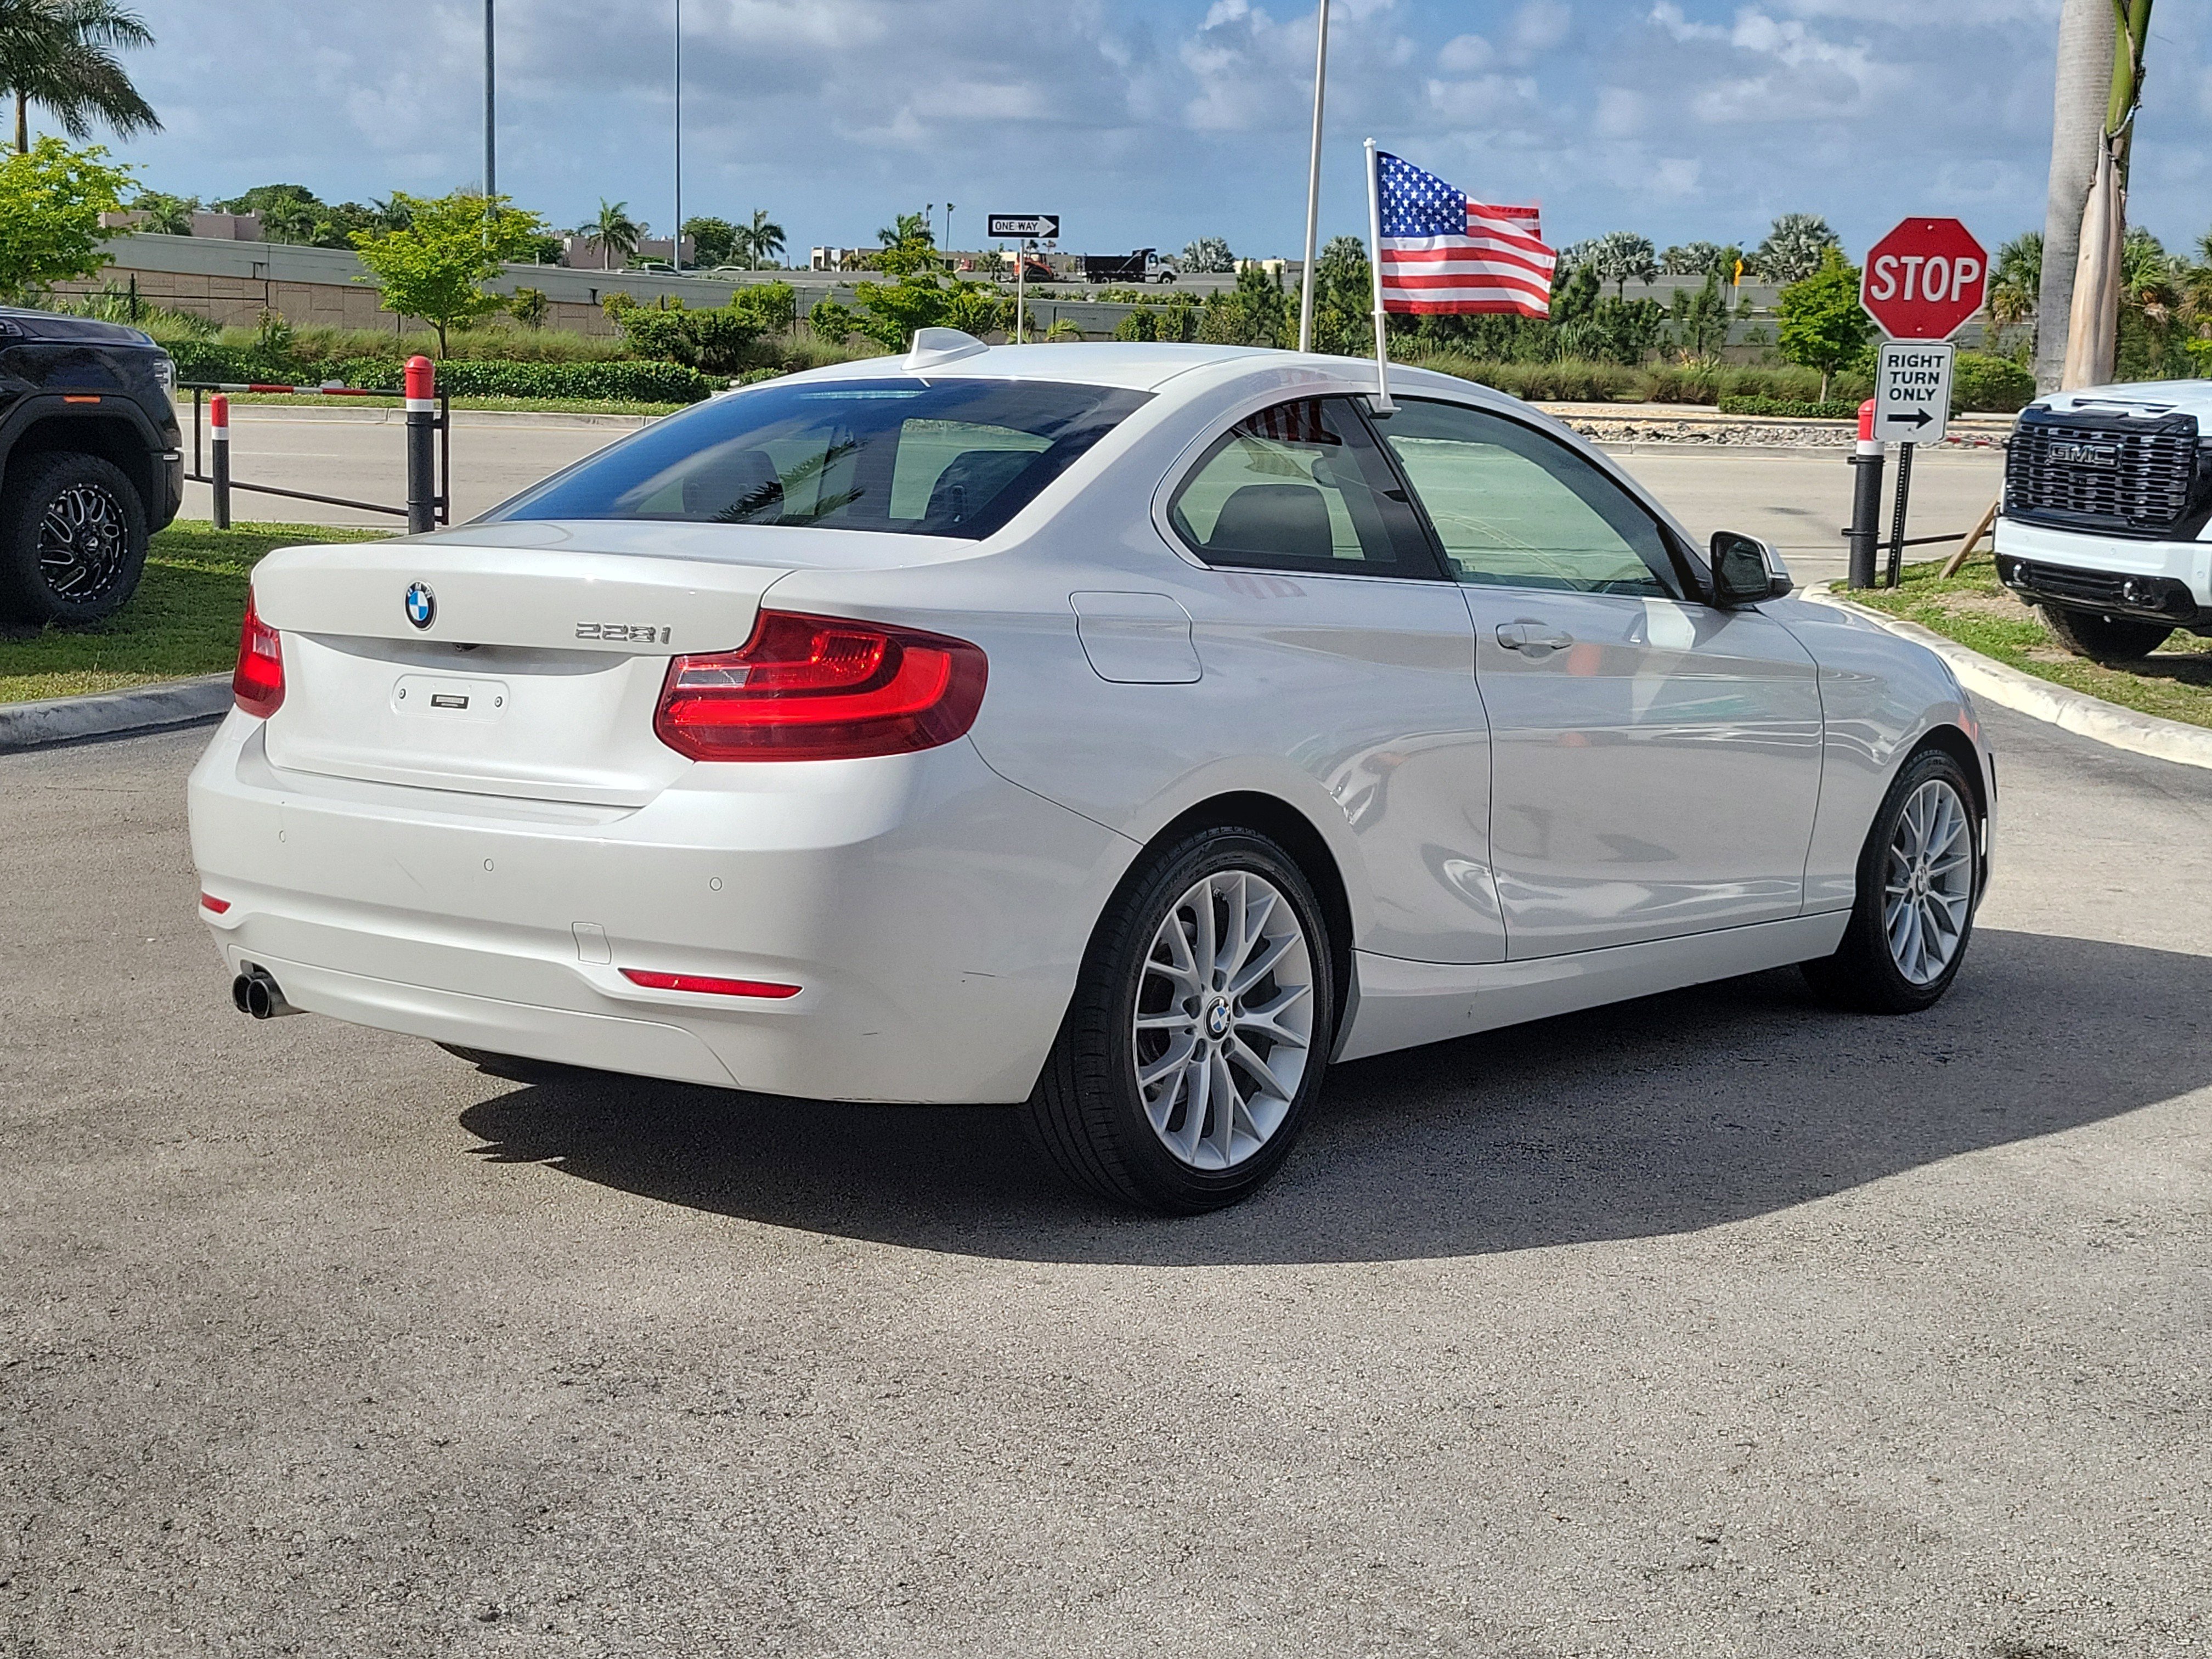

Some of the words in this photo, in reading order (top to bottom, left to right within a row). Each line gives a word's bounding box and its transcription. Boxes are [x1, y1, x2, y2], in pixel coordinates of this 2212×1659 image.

[995, 221, 1014, 230] ONE
[1018, 222, 1038, 230] WAY
[1870, 255, 1980, 302] STOP
[1888, 354, 1945, 368] RIGHT
[1890, 371, 1940, 385] TURN
[1889, 387, 1937, 401] ONLY
[2049, 442, 2117, 466] GMC
